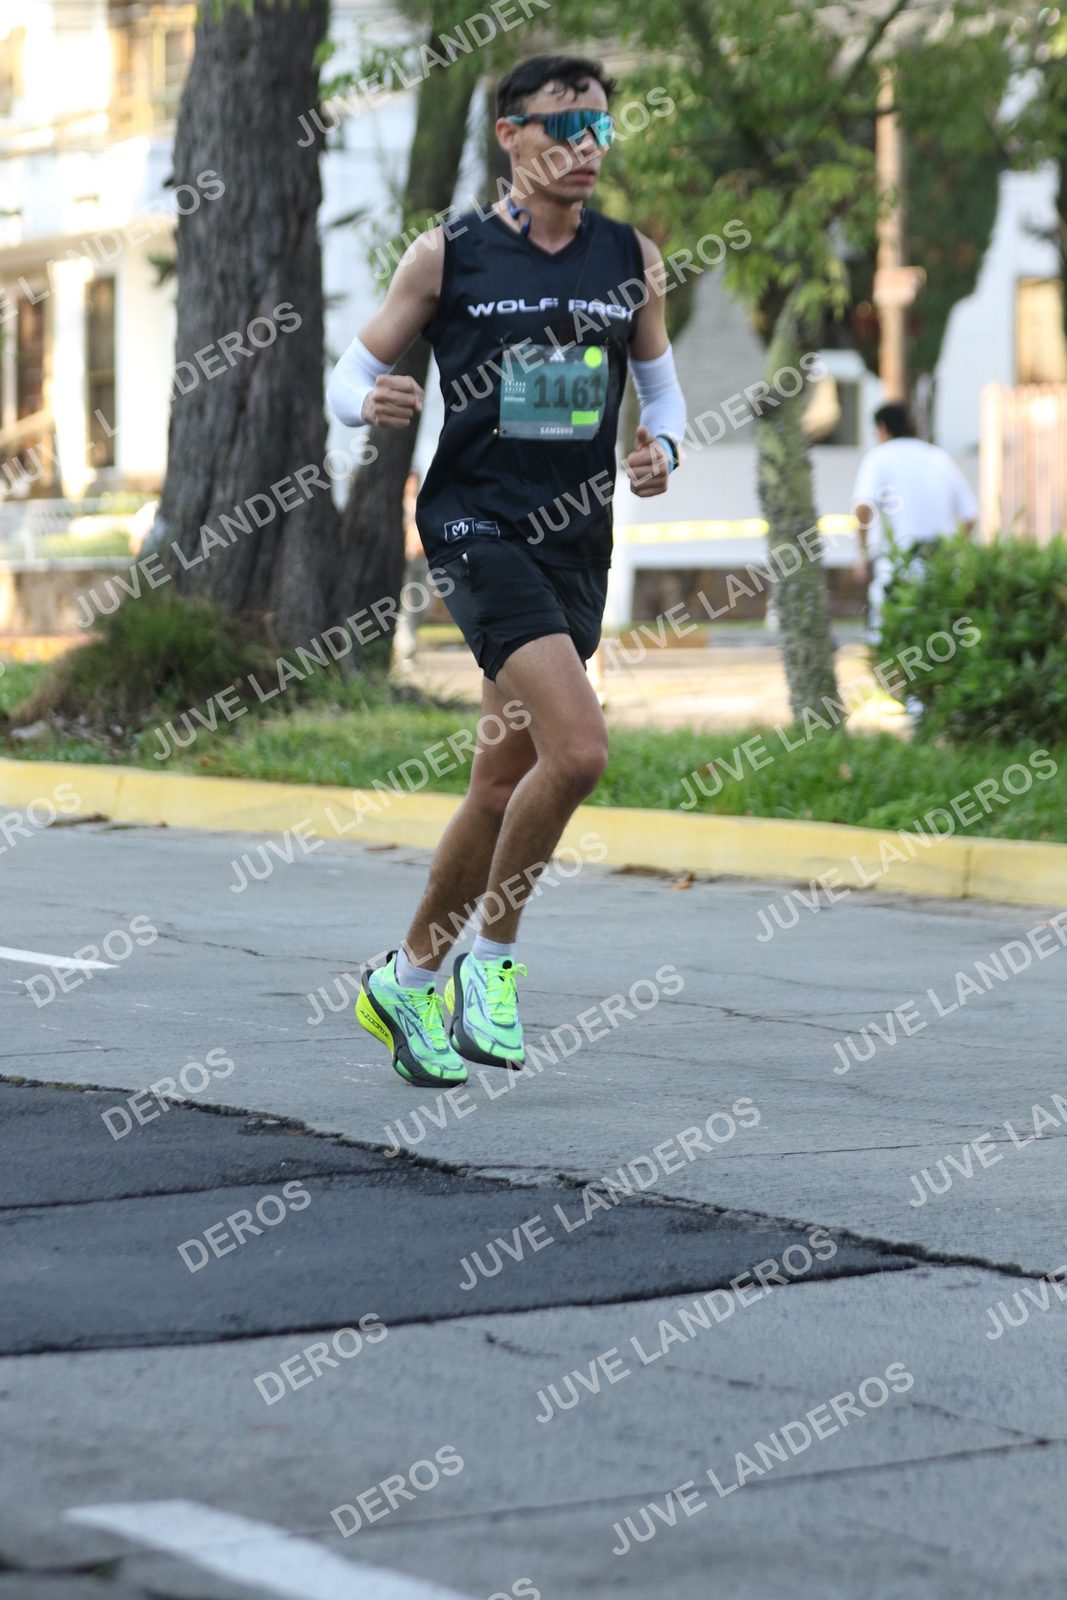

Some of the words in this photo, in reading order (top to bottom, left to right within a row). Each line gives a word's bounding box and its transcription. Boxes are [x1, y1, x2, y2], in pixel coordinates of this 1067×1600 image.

[467, 297, 559, 318] WOLF
[533, 374, 602, 408] 1161
[540, 426, 574, 435] SAMSUNG
